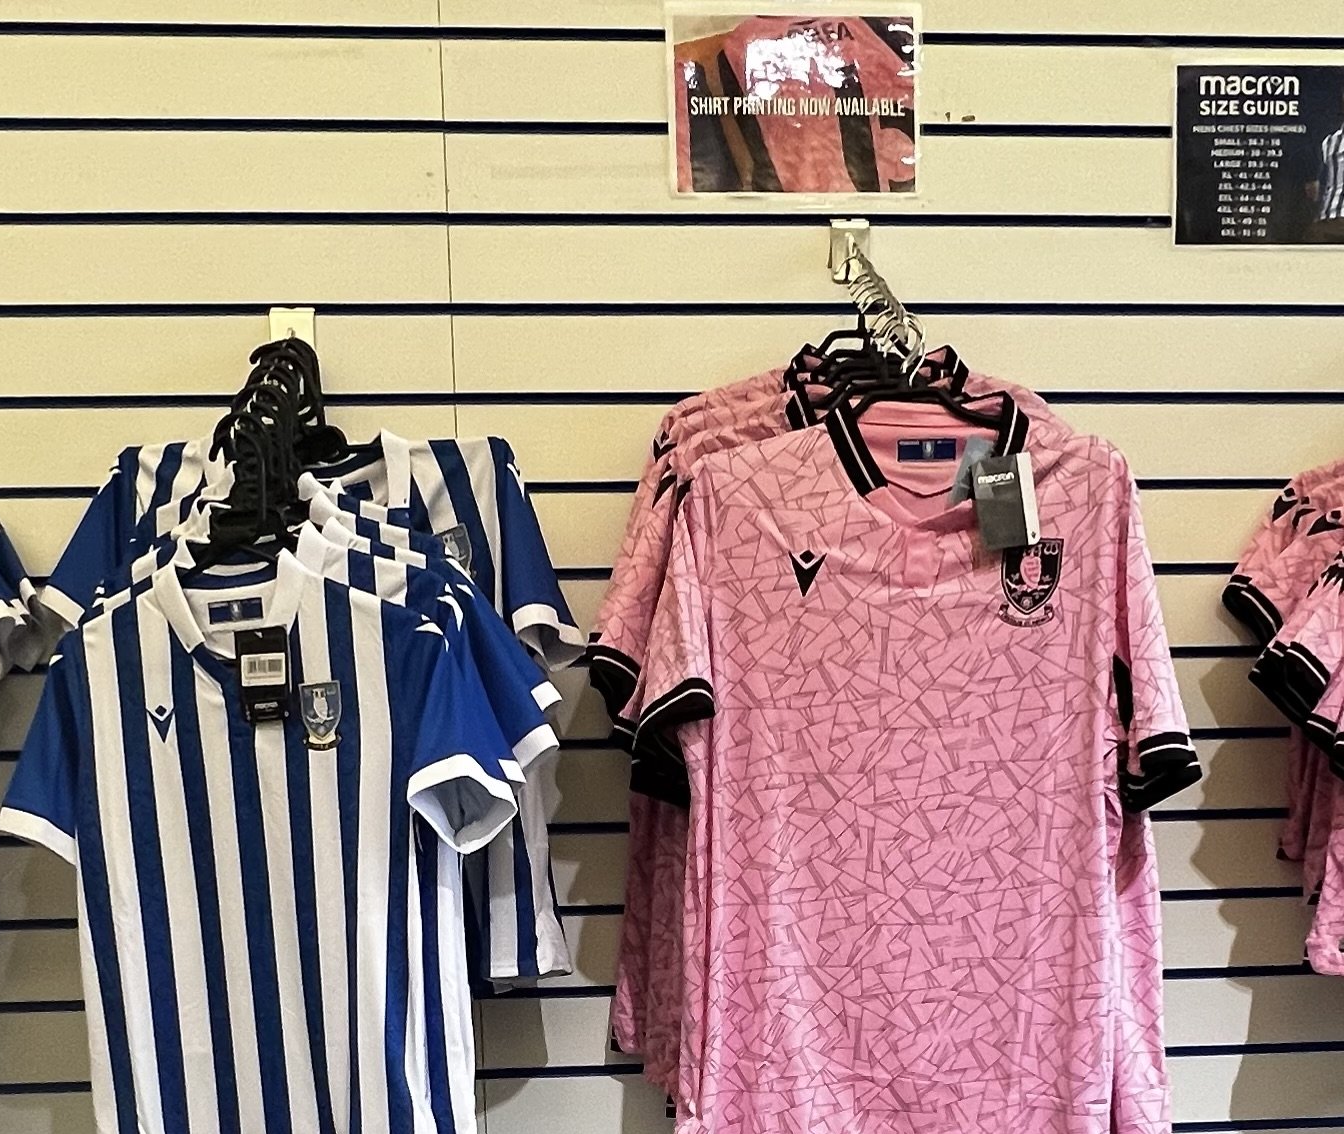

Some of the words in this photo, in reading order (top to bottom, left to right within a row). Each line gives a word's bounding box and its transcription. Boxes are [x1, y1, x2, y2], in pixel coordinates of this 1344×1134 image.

[1199, 75, 1300, 96] macron
[690, 96, 730, 116] SHIRT
[733, 96, 796, 116] PRINTING
[799, 97, 831, 116] NOW
[834, 97, 906, 117] AVAILABLE
[1199, 100, 1240, 116] SIZE
[1242, 100, 1300, 116] GUIDE
